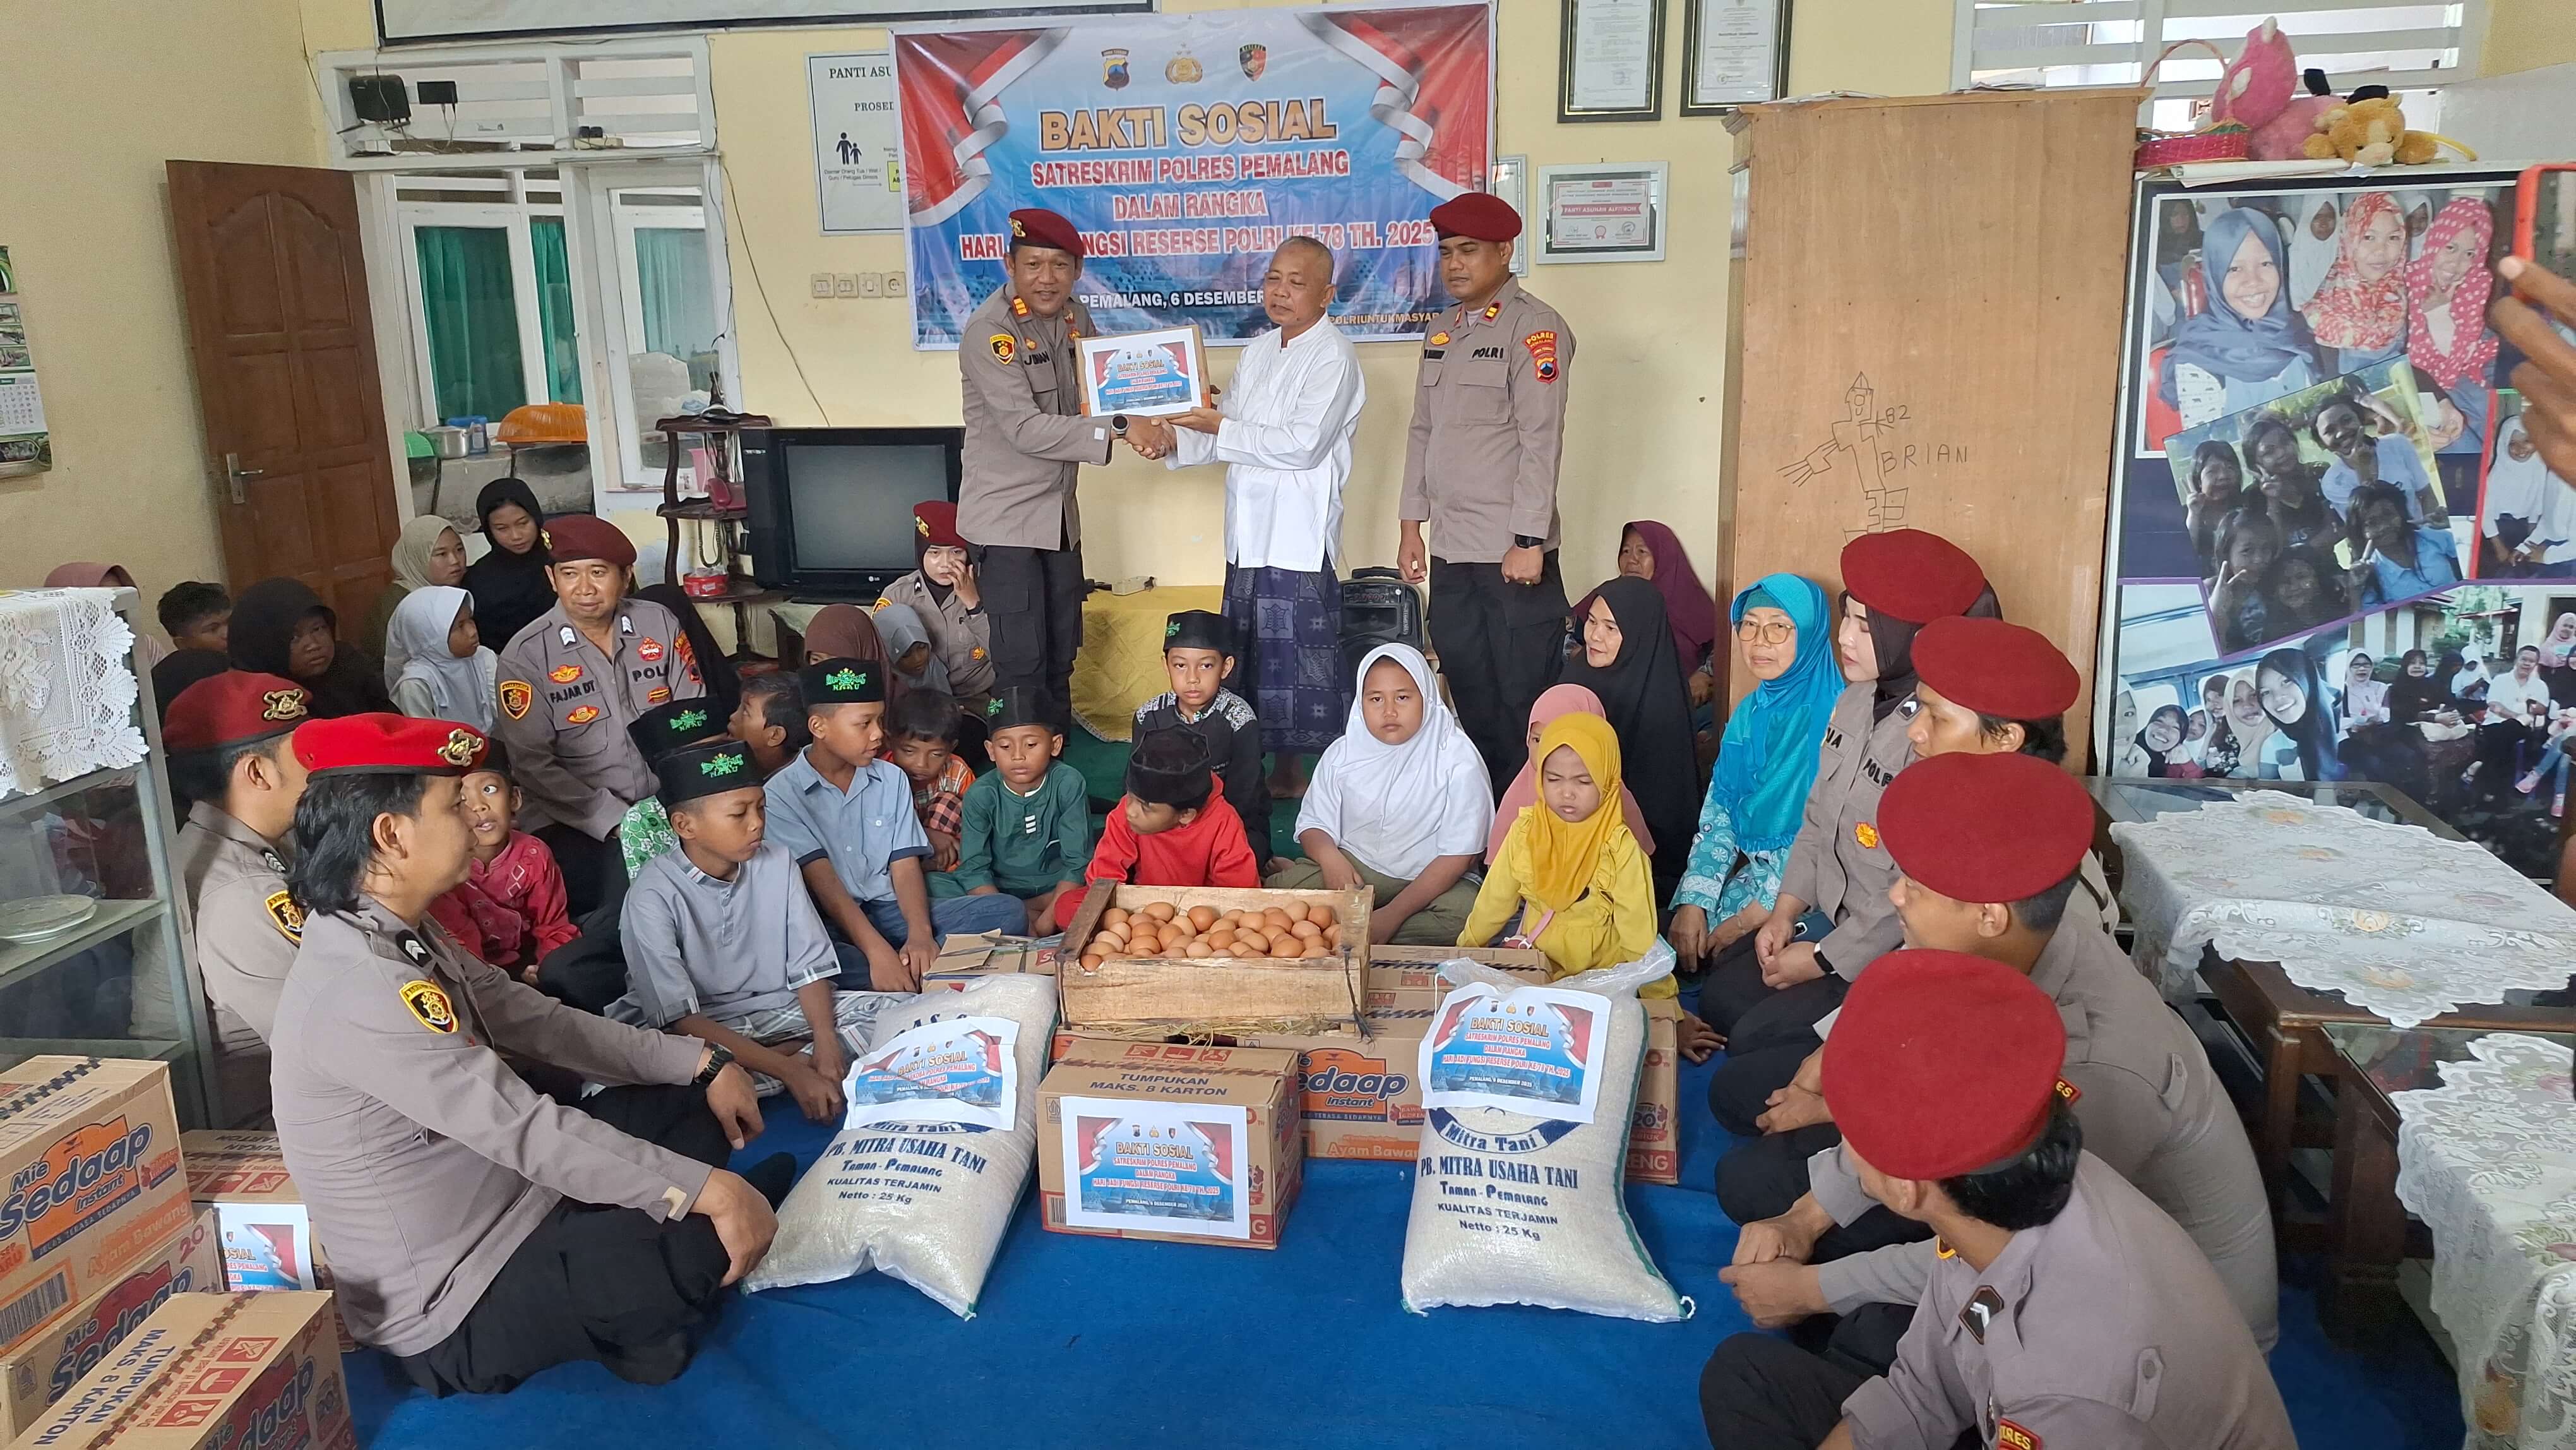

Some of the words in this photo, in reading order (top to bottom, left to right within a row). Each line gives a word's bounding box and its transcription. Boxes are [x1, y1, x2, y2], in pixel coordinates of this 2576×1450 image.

[829, 67, 866, 78] PANTI
[870, 66, 891, 77] ASU
[854, 101, 894, 112] PROSE
[1040, 105, 1167, 151] BAKTI
[1178, 99, 1337, 147] SOSIAL
[1032, 158, 1153, 187] SATRESKRIM
[1159, 155, 1234, 183] POLRES
[1241, 150, 1350, 179] PEMALANG
[1114, 193, 1179, 220] DALAM
[1185, 191, 1267, 218] RANGKA
[960, 234, 1005, 260] HARI
[1082, 231, 1127, 257] NGSI
[1132, 227, 1220, 256] RESERSE
[1224, 224, 1283, 253] POLRI
[1347, 222, 1382, 248] TH.
[1386, 220, 1434, 247] 2025
[1080, 292, 1167, 309] PEMALANG,
[1170, 294, 1180, 306] 6
[1184, 291, 1263, 306] DESEMBER
[1527, 332, 1554, 344] POLRES
[1472, 347, 1504, 359] POLRI
[1880, 443, 1967, 477] BRIAN
[633, 664, 668, 682] POL
[550, 685, 582, 703] FAJAR
[1863, 758, 1894, 787] POLR
[1470, 1017, 1505, 1031] BAKTI
[1506, 1020, 1549, 1037] SOSIAL
[1484, 1045, 1502, 1053] DALAM
[1502, 1047, 1526, 1057] RANGKA
[1498, 1034, 1520, 1045] POLRES
[1520, 1038, 1551, 1049] PEMALANG
[898, 1058, 927, 1075] BAKTI
[928, 1050, 968, 1067] SOSIAL
[1466, 1056, 1486, 1064] FUNGSI
[1486, 1057, 1511, 1067] RESERSE
[1090, 1082, 1140, 1092] MAKS.
[1145, 1084, 1156, 1093] 8
[1160, 1086, 1227, 1096] KARTON
[1120, 1074, 1209, 1086] TUMPUKAN
[1298, 1066, 1409, 1101] edaap
[1326, 1096, 1374, 1108] Instant
[1445, 1122, 1486, 1149] Mitra
[1495, 1134, 1537, 1151] Tani
[826, 1141, 845, 1158] PB.
[851, 1137, 896, 1154] MITRA
[898, 1138, 947, 1158] USAHA
[950, 1146, 987, 1174] TANI
[1116, 1142, 1150, 1155] BAKTI
[1154, 1144, 1194, 1159] SOSIAL
[1328, 1142, 1369, 1157] Ayam
[1113, 1158, 1147, 1166] SATRESKRIM
[1147, 1159, 1167, 1168] POLRES
[1169, 1161, 1196, 1171] PEMALANG
[1627, 1154, 1669, 1171] ENG
[0, 1123, 153, 1240] Sedaap
[9, 1161, 51, 1195] Mie
[1136, 1170, 1154, 1178] DALAM
[1421, 1157, 1436, 1177] PB.
[1440, 1156, 1483, 1177] MITRA
[1489, 1159, 1540, 1184] USAHA
[1545, 1166, 1578, 1189] TANI
[75, 1172, 125, 1213] Instant
[827, 1178, 880, 1186] KUALITAS
[884, 1178, 942, 1193] TERJAMIN
[1119, 1180, 1139, 1188] FUNGSI
[838, 1191, 869, 1200] Netto
[879, 1192, 893, 1200] 25
[896, 1193, 912, 1205] Kg
[1438, 1202, 1492, 1216] KUALITAS
[1495, 1207, 1558, 1225] TERJAMIN
[1459, 1219, 1491, 1231] Netto
[1503, 1225, 1518, 1236] 25
[1522, 1228, 1541, 1241] Kg
[224, 1247, 256, 1261] OSIAL
[61, 1319, 99, 1358] Mie
[110, 1329, 167, 1370] MAKS.
[85, 1345, 176, 1423] TUMPUKAN
[100, 1374, 120, 1383] 8
[239, 1355, 314, 1450] daap
[33, 1387, 104, 1446] KARTON
[2000, 1425, 2031, 1450] LRES
